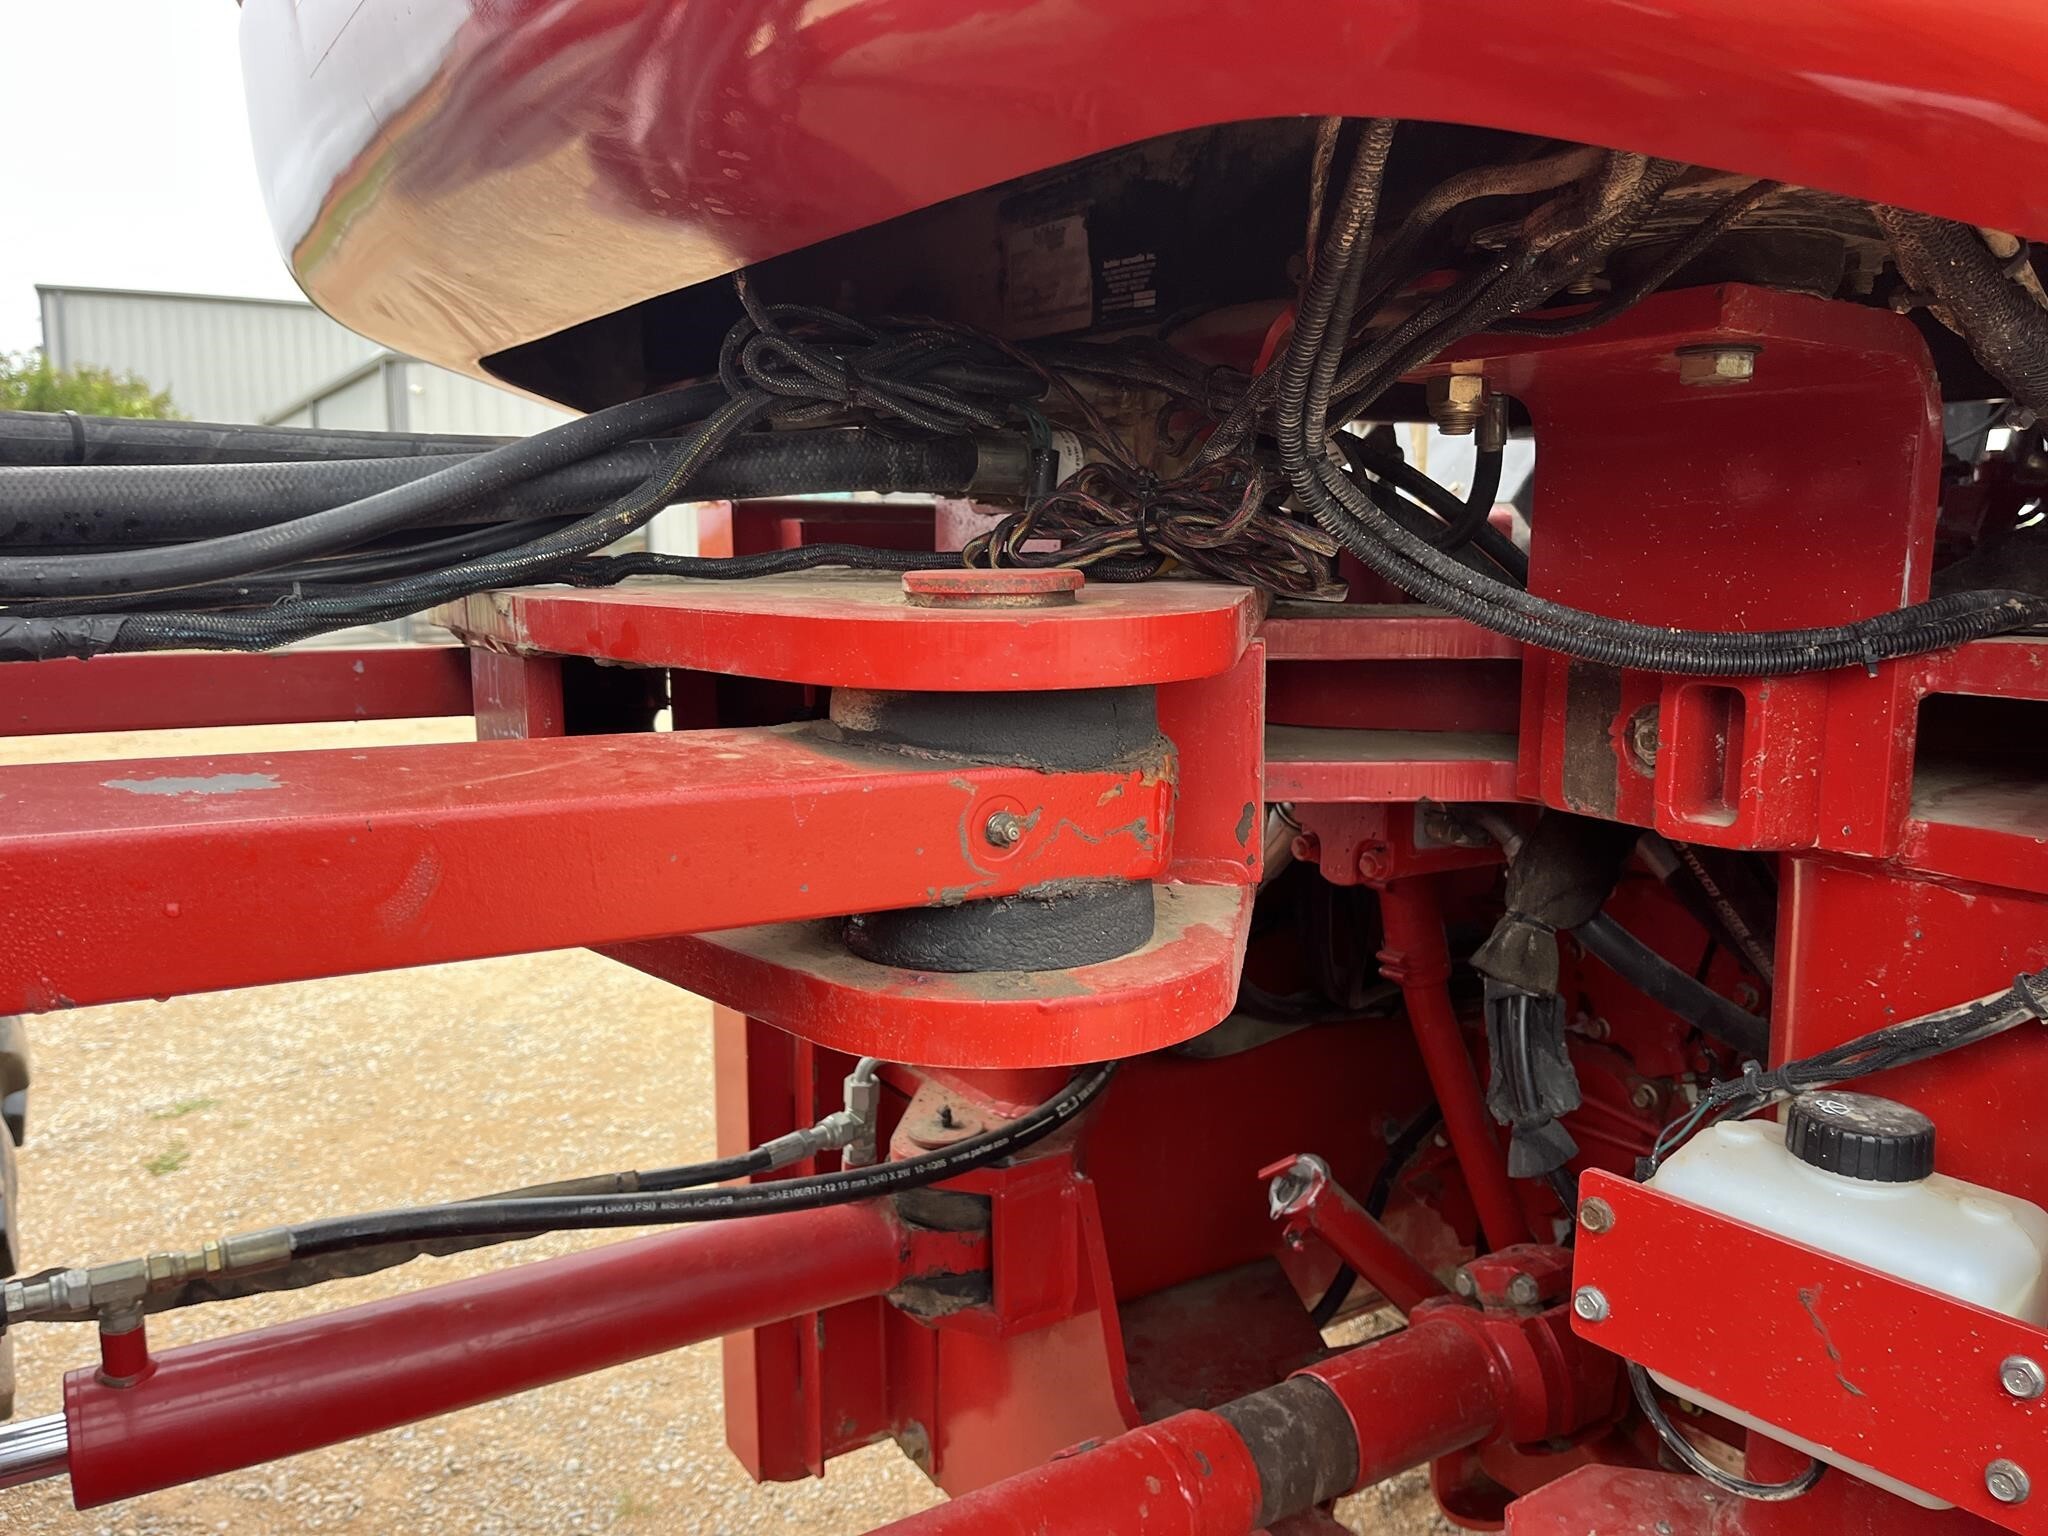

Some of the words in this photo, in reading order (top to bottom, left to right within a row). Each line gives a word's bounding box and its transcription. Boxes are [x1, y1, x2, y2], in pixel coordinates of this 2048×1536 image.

[1718, 900, 1751, 937] COVER
[635, 1202, 656, 1212] PSI)
[889, 1171, 897, 1179] X
